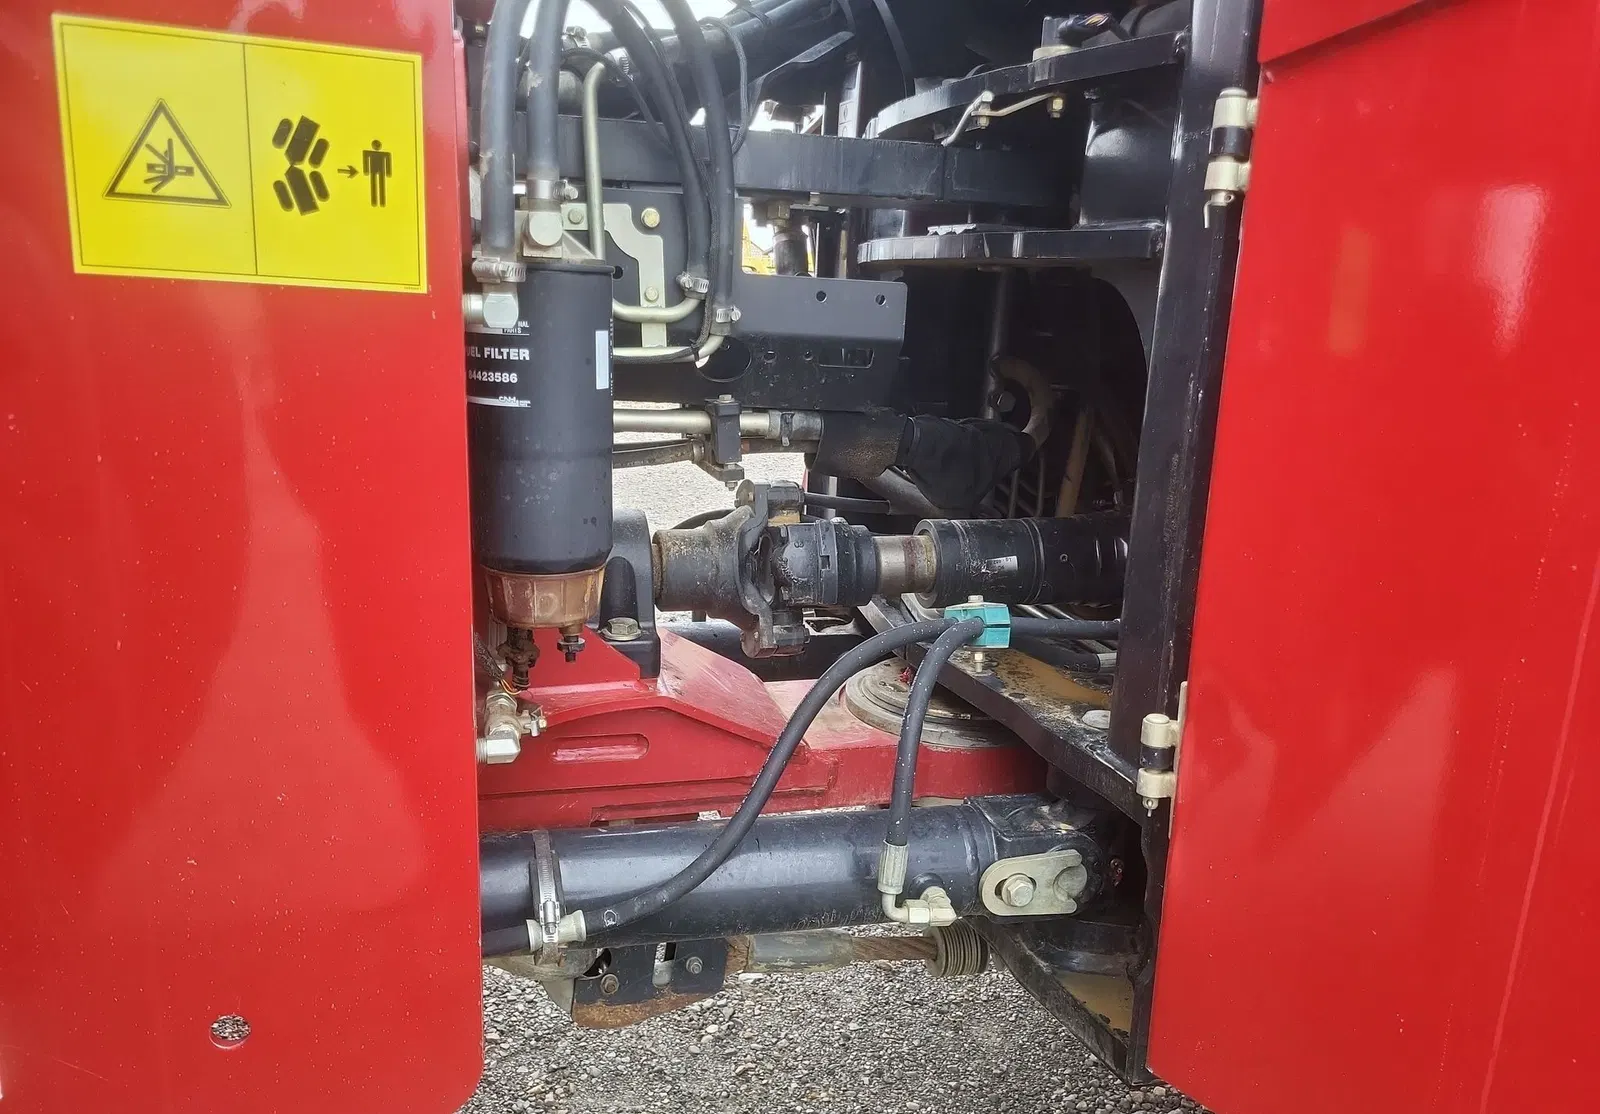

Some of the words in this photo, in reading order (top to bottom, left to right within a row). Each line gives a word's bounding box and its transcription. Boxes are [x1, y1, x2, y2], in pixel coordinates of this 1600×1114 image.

[467, 346, 480, 357] UEL
[484, 348, 529, 360] FILTER
[469, 370, 517, 383] 84423586
